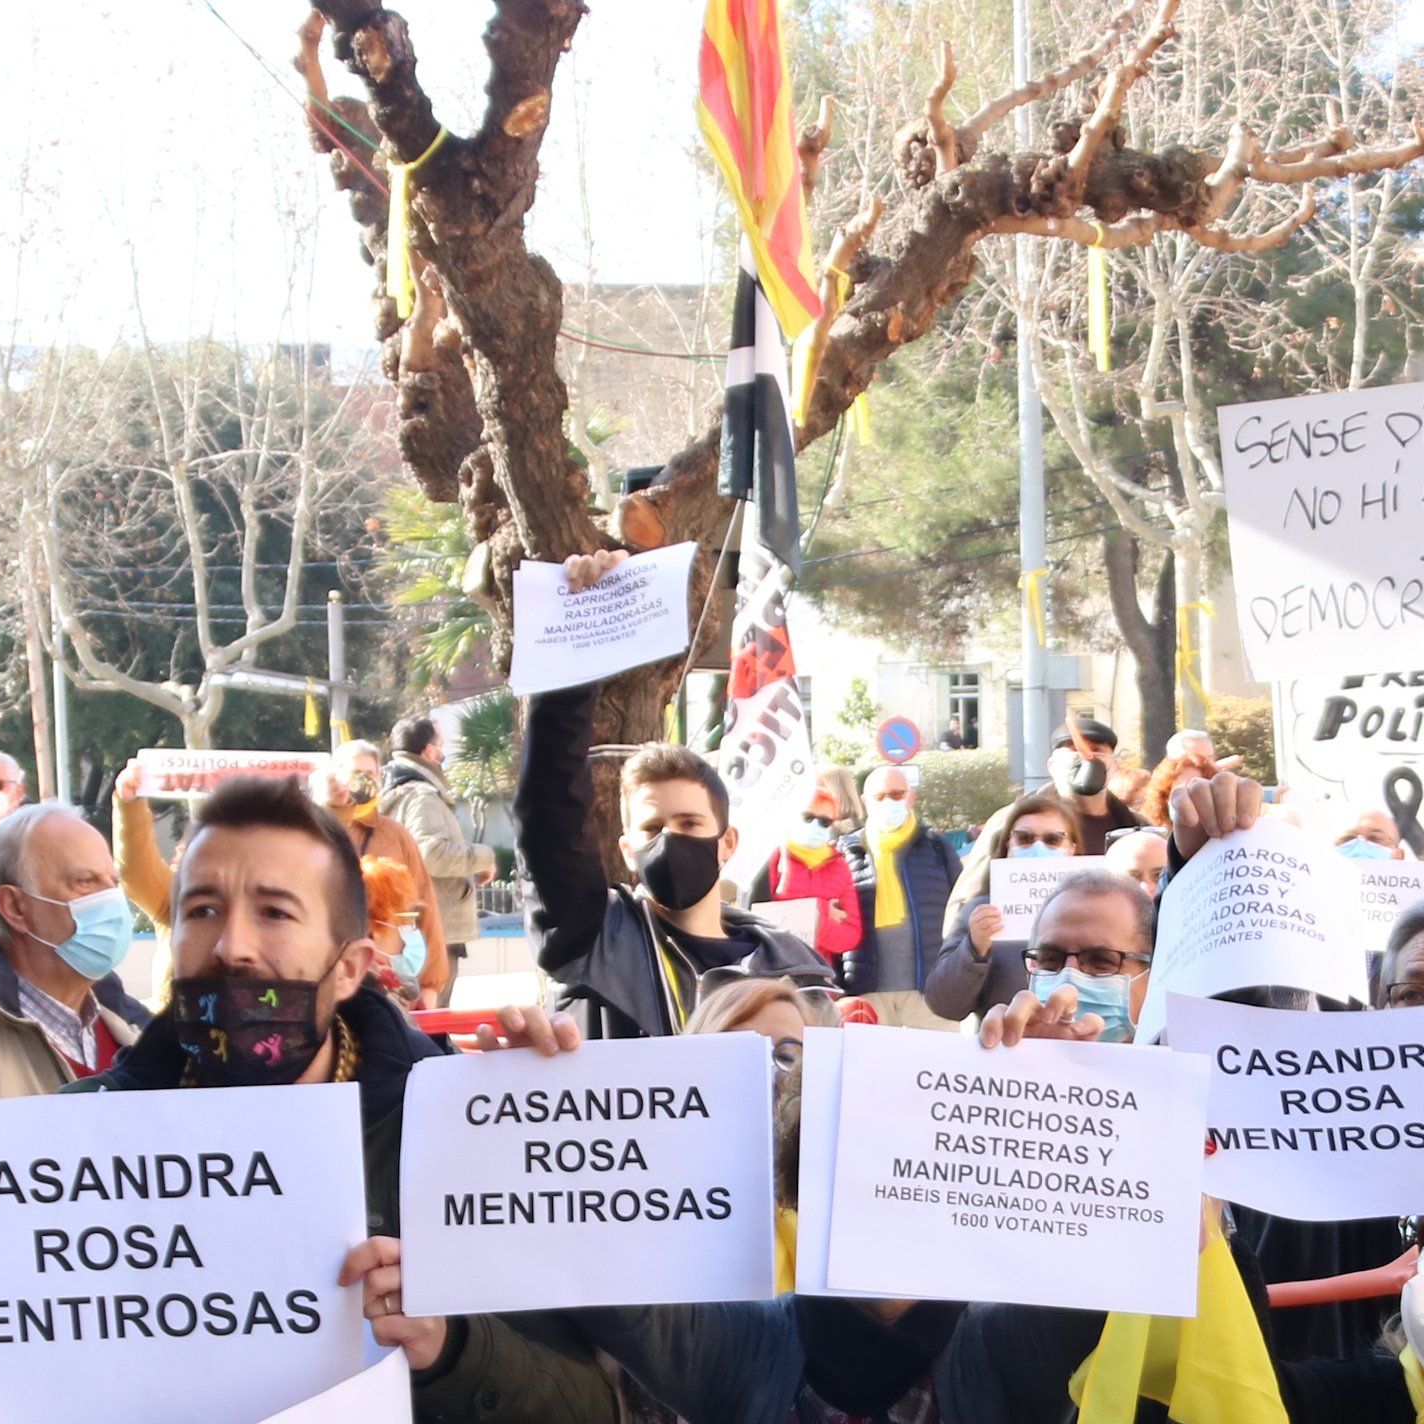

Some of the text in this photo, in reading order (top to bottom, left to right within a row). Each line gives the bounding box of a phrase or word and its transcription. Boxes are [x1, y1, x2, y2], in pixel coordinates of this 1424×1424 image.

[1234, 410, 1368, 469] SENSE
[1282, 486, 1341, 531] NO
[1277, 887, 1289, 899] Y
[1236, 919, 1245, 929] A
[1250, 918, 1326, 942] VUESTROS
[465, 1085, 710, 1126] CASANDRA
[916, 1069, 1139, 1111] CASANDRA-ROSA
[1280, 1083, 1405, 1115] ROSA
[930, 1101, 1121, 1142] CAPRICHOSAS,
[524, 1138, 648, 1173] ROSA
[934, 1131, 1113, 1167] RASTRERAS Y
[892, 1157, 1151, 1201] MANIPULADORASAS
[443, 1187, 732, 1226] MENTIROSAS
[875, 1183, 1164, 1224] HABÉIS ENGAÑADO A VUESTROS
[950, 1212, 1089, 1237] 1600 VOTANTES
[33, 1223, 204, 1274] ROSA
